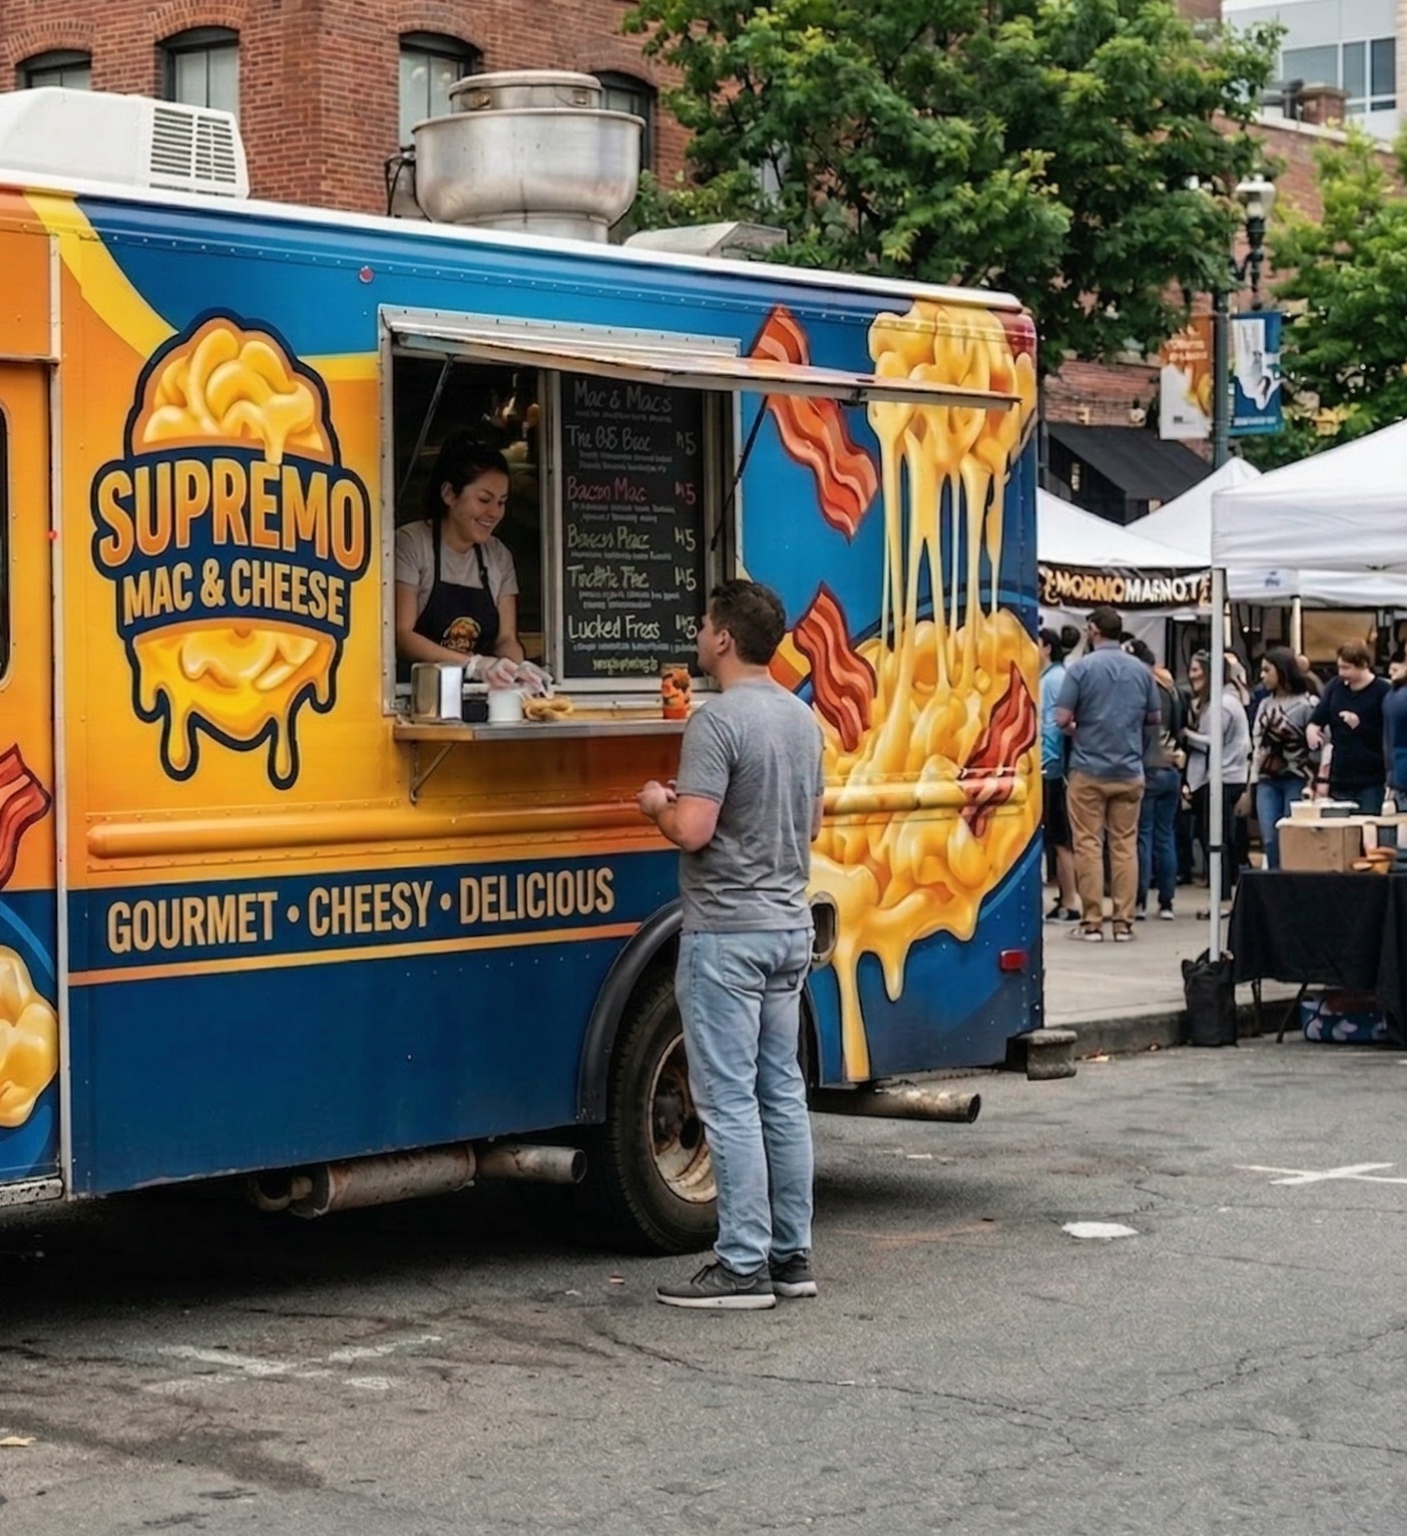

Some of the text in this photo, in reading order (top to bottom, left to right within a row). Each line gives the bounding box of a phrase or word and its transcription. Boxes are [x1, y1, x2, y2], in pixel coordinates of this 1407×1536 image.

[574, 380, 607, 408] Mac
[98, 458, 365, 571] SUPREMO
[123, 558, 345, 628] MAC & CHEESE
[106, 891, 278, 954] GOURMET
[308, 880, 434, 938] CHEESY
[459, 866, 616, 925] DELICIOUS
